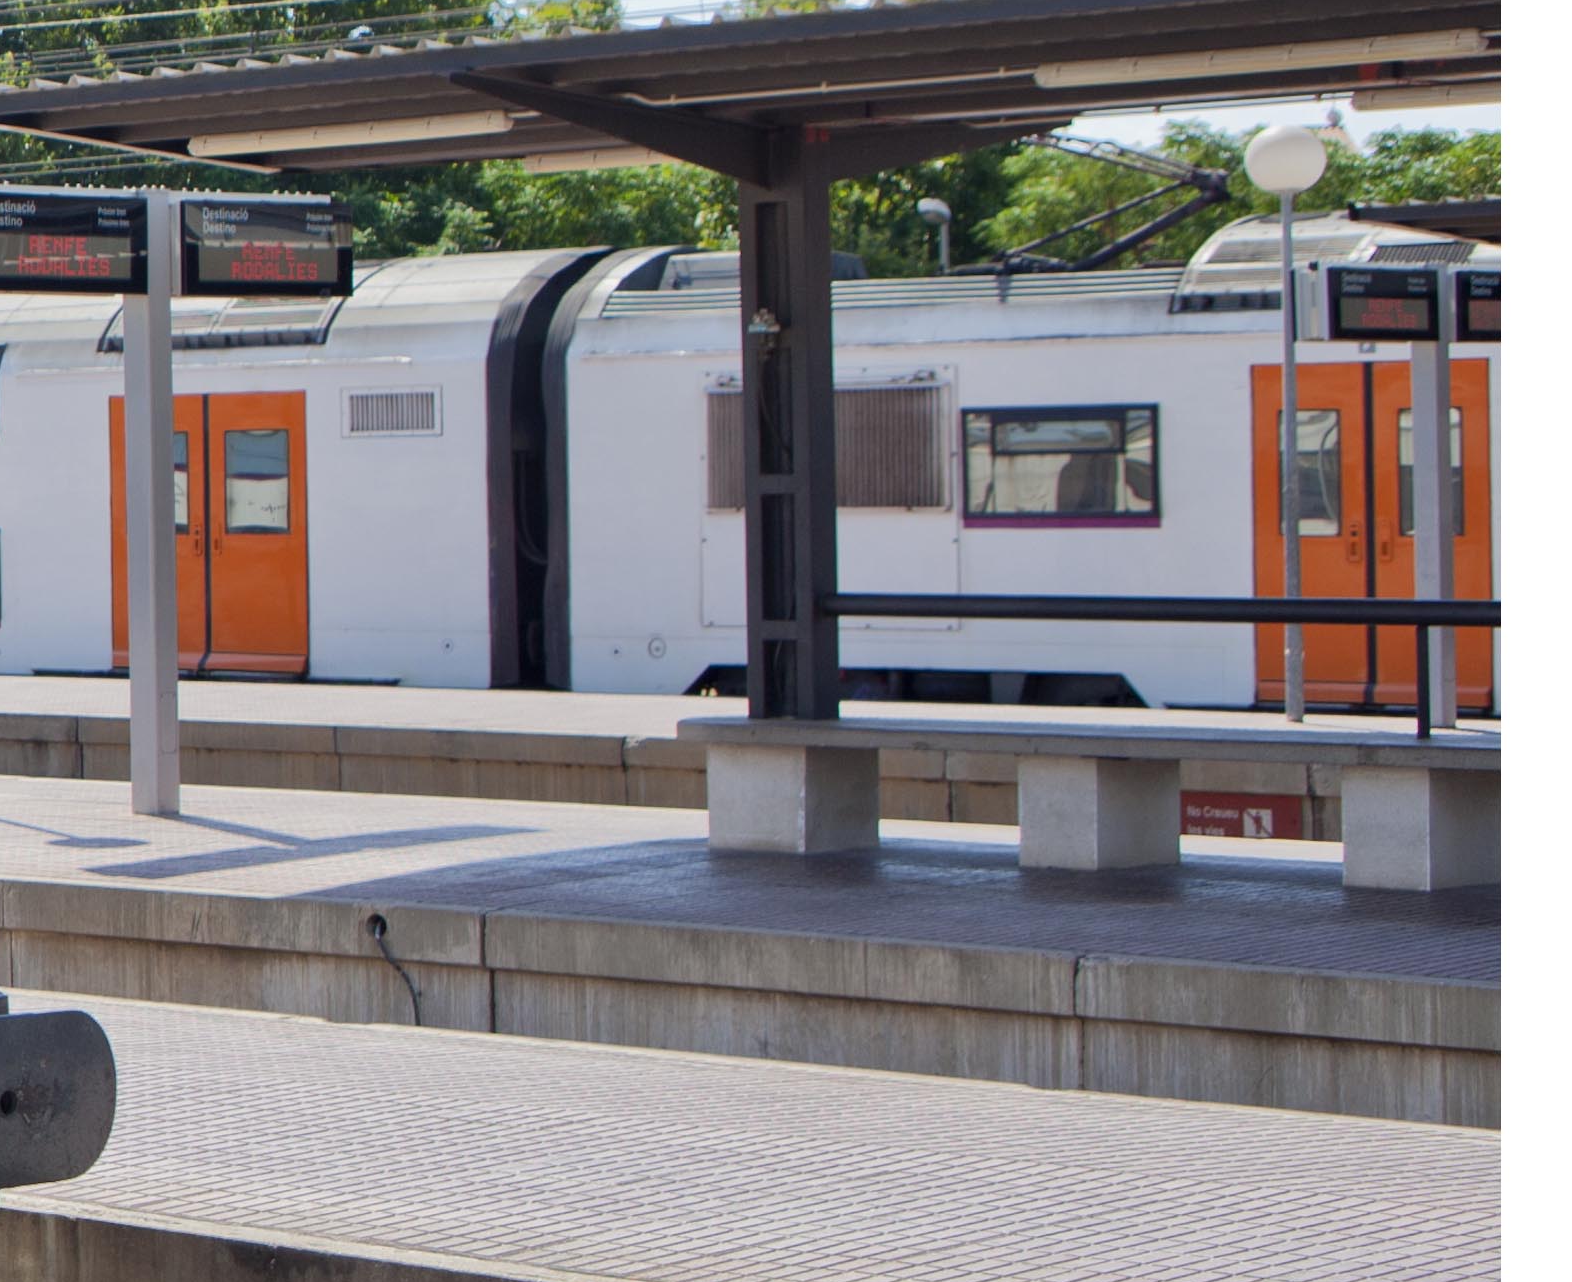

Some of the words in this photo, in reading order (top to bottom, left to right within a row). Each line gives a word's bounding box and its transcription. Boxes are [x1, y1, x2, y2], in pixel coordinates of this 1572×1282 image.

[202, 207, 249, 221] Destinació
[202, 221, 236, 234] Destino
[29, 235, 88, 255] RENFE
[242, 242, 295, 261] RENFE
[18, 255, 110, 277] RODALIES
[230, 261, 318, 281] RODALIES
[1187, 805, 1202, 817] No
